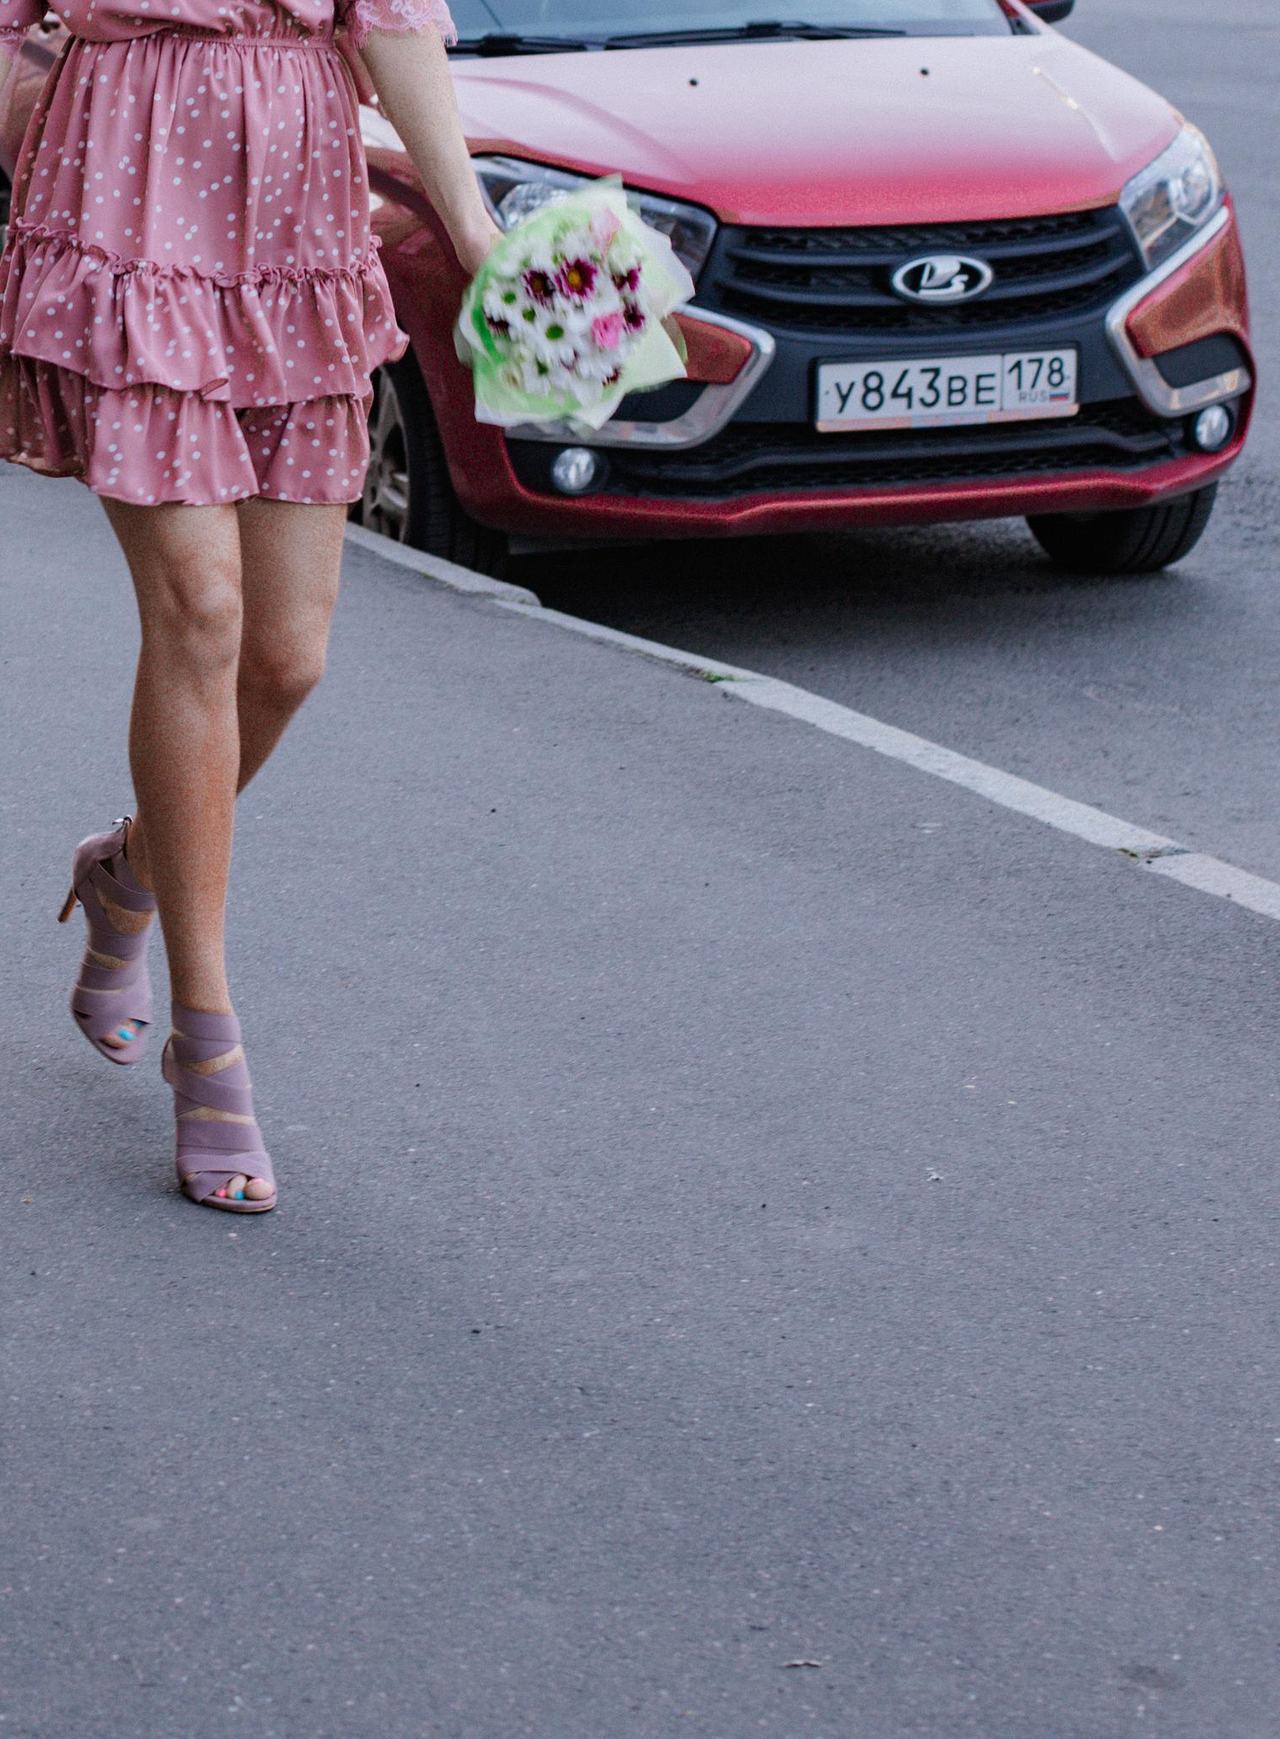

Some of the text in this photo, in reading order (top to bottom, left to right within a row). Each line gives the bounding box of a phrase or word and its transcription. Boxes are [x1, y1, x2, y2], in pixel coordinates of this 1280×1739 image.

[834, 356, 1065, 414] У843ВЕ 178
[1018, 389, 1048, 403] RUS
